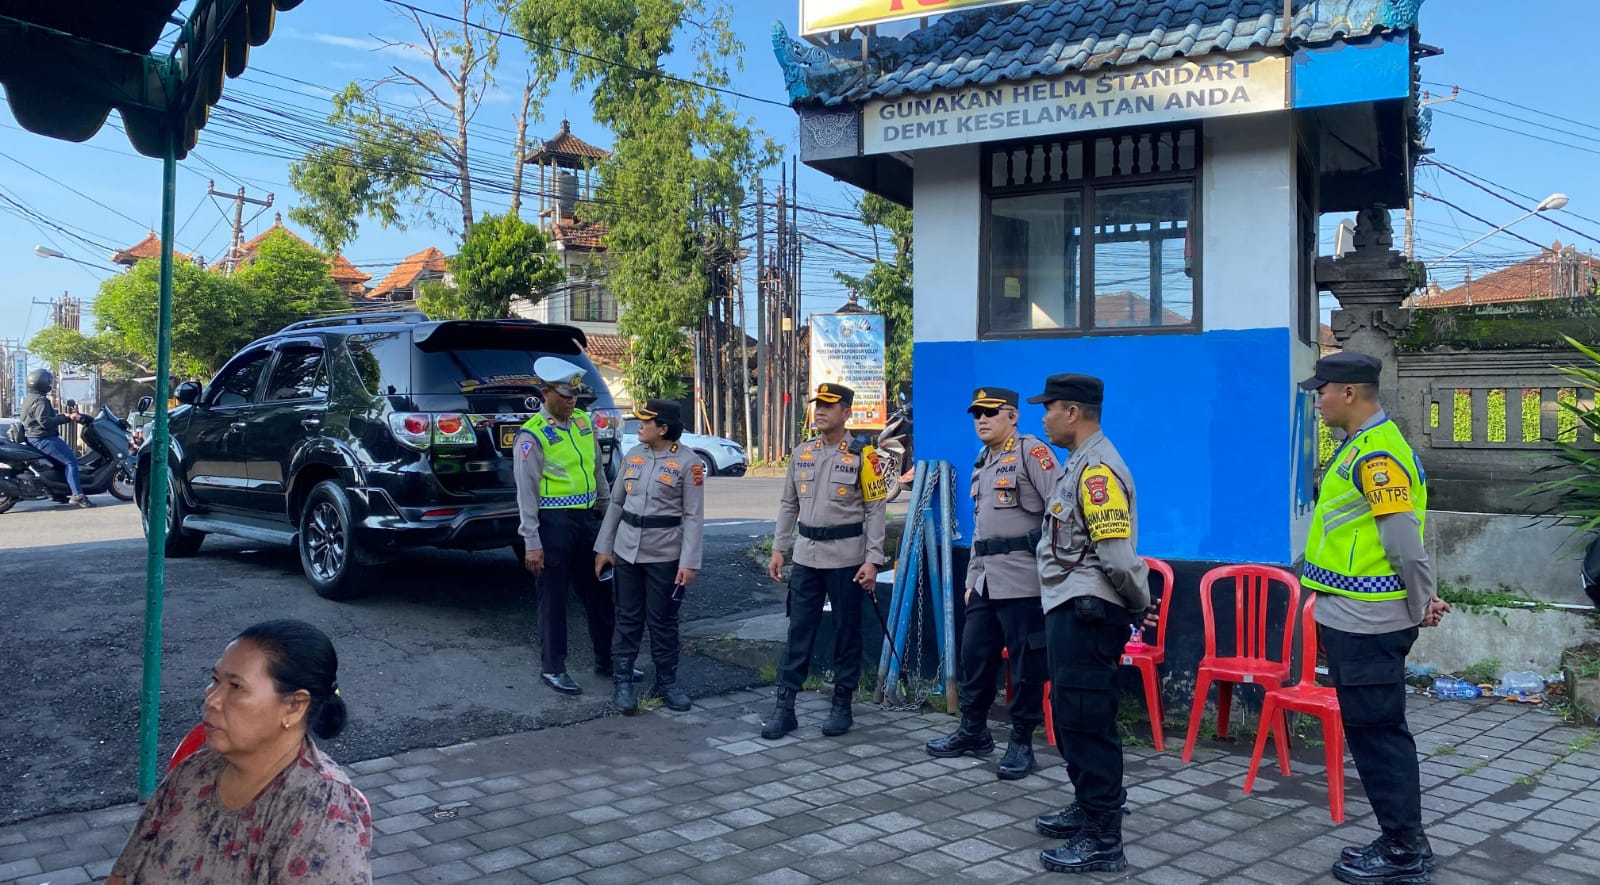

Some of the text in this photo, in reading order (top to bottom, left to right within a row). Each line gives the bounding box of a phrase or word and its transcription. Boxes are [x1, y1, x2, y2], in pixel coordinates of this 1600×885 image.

[879, 60, 1251, 121] GUNAKAN HELM STANDART
[883, 85, 1251, 142] DEMI KESELAMATAN ANDA
[659, 465, 681, 477] POLRI
[834, 464, 857, 473] POLRI
[995, 465, 1017, 475] POLRI
[1385, 488, 1409, 502] TPS
